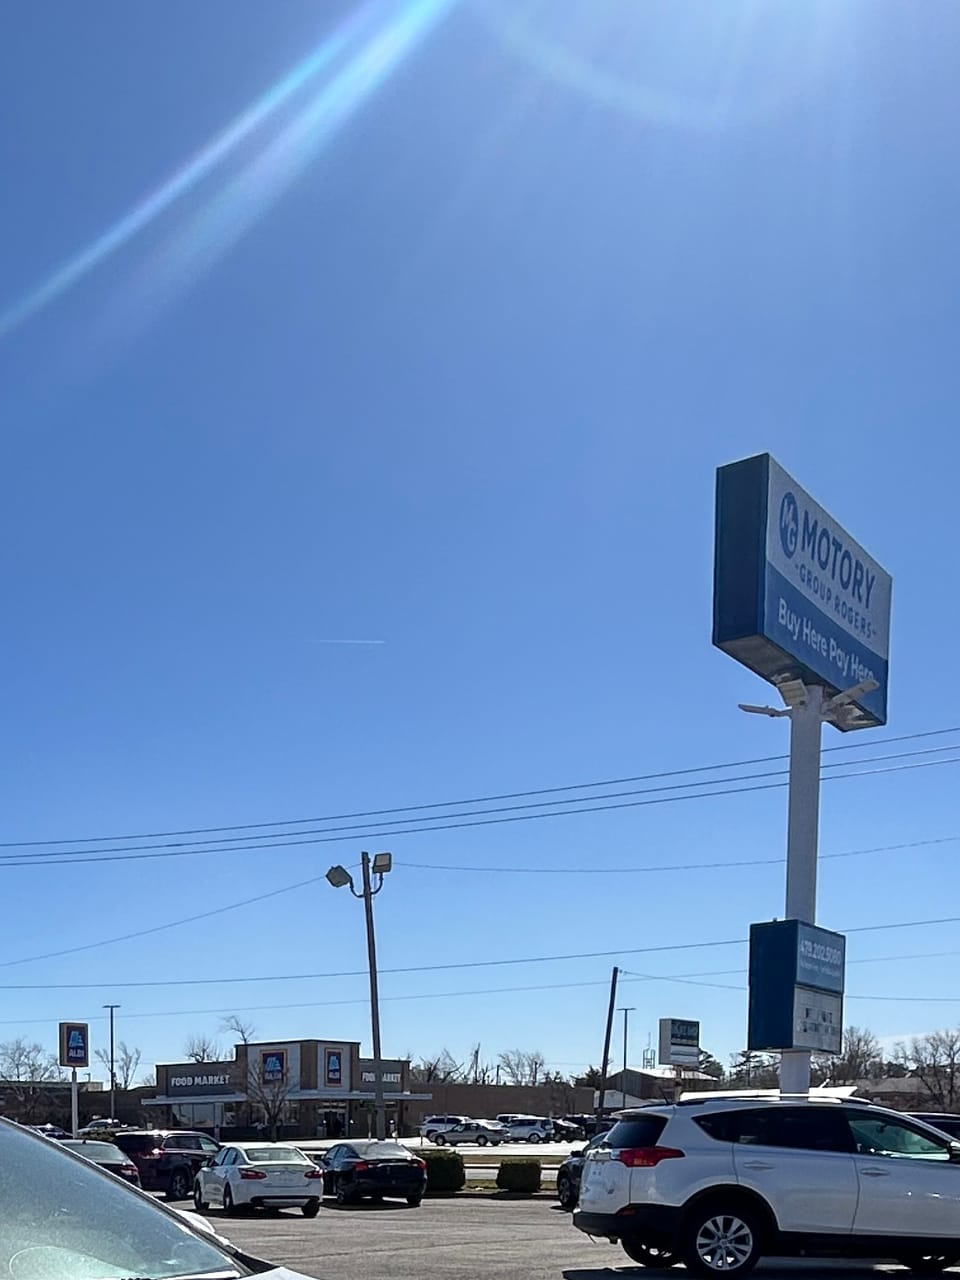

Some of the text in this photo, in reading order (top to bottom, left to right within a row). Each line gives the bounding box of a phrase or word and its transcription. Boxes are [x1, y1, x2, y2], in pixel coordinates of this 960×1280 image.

[801, 509, 876, 610] MOTORY
[778, 597, 801, 641] Buy
[802, 616, 828, 657] Here
[829, 637, 850, 677] Pay
[171, 1074, 231, 1088] FOOD MARKET
